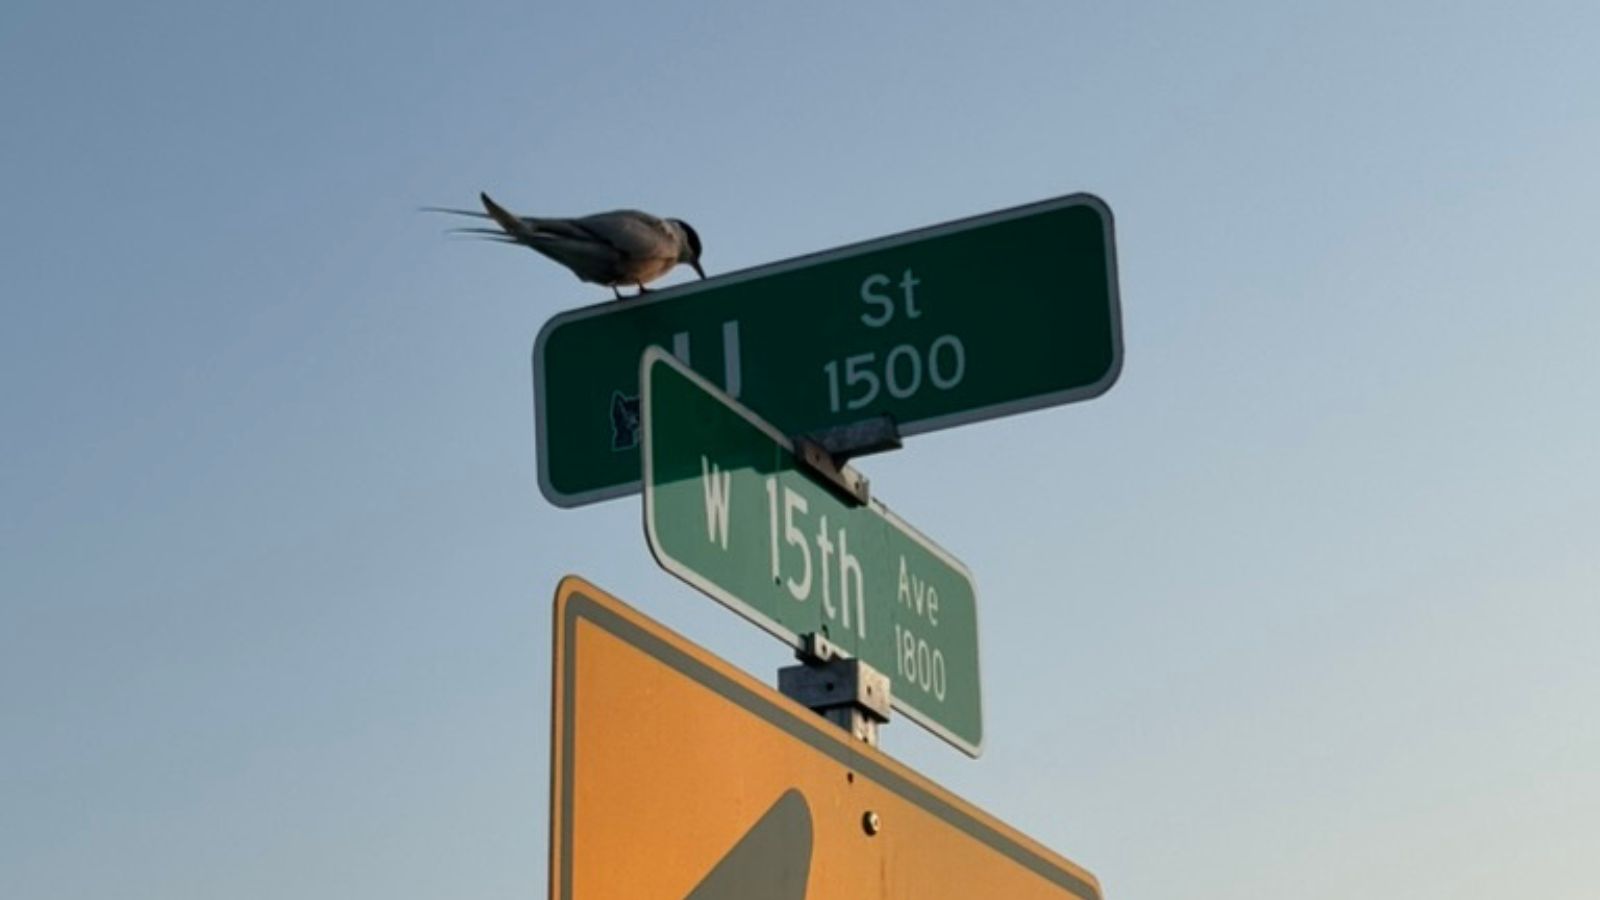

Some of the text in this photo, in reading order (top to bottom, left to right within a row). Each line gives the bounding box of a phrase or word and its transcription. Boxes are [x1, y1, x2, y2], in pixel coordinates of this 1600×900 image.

[860, 268, 921, 328] St
[823, 335, 966, 413] 1500
[702, 454, 939, 640] W 15th Ave
[895, 624, 946, 702] 1800
